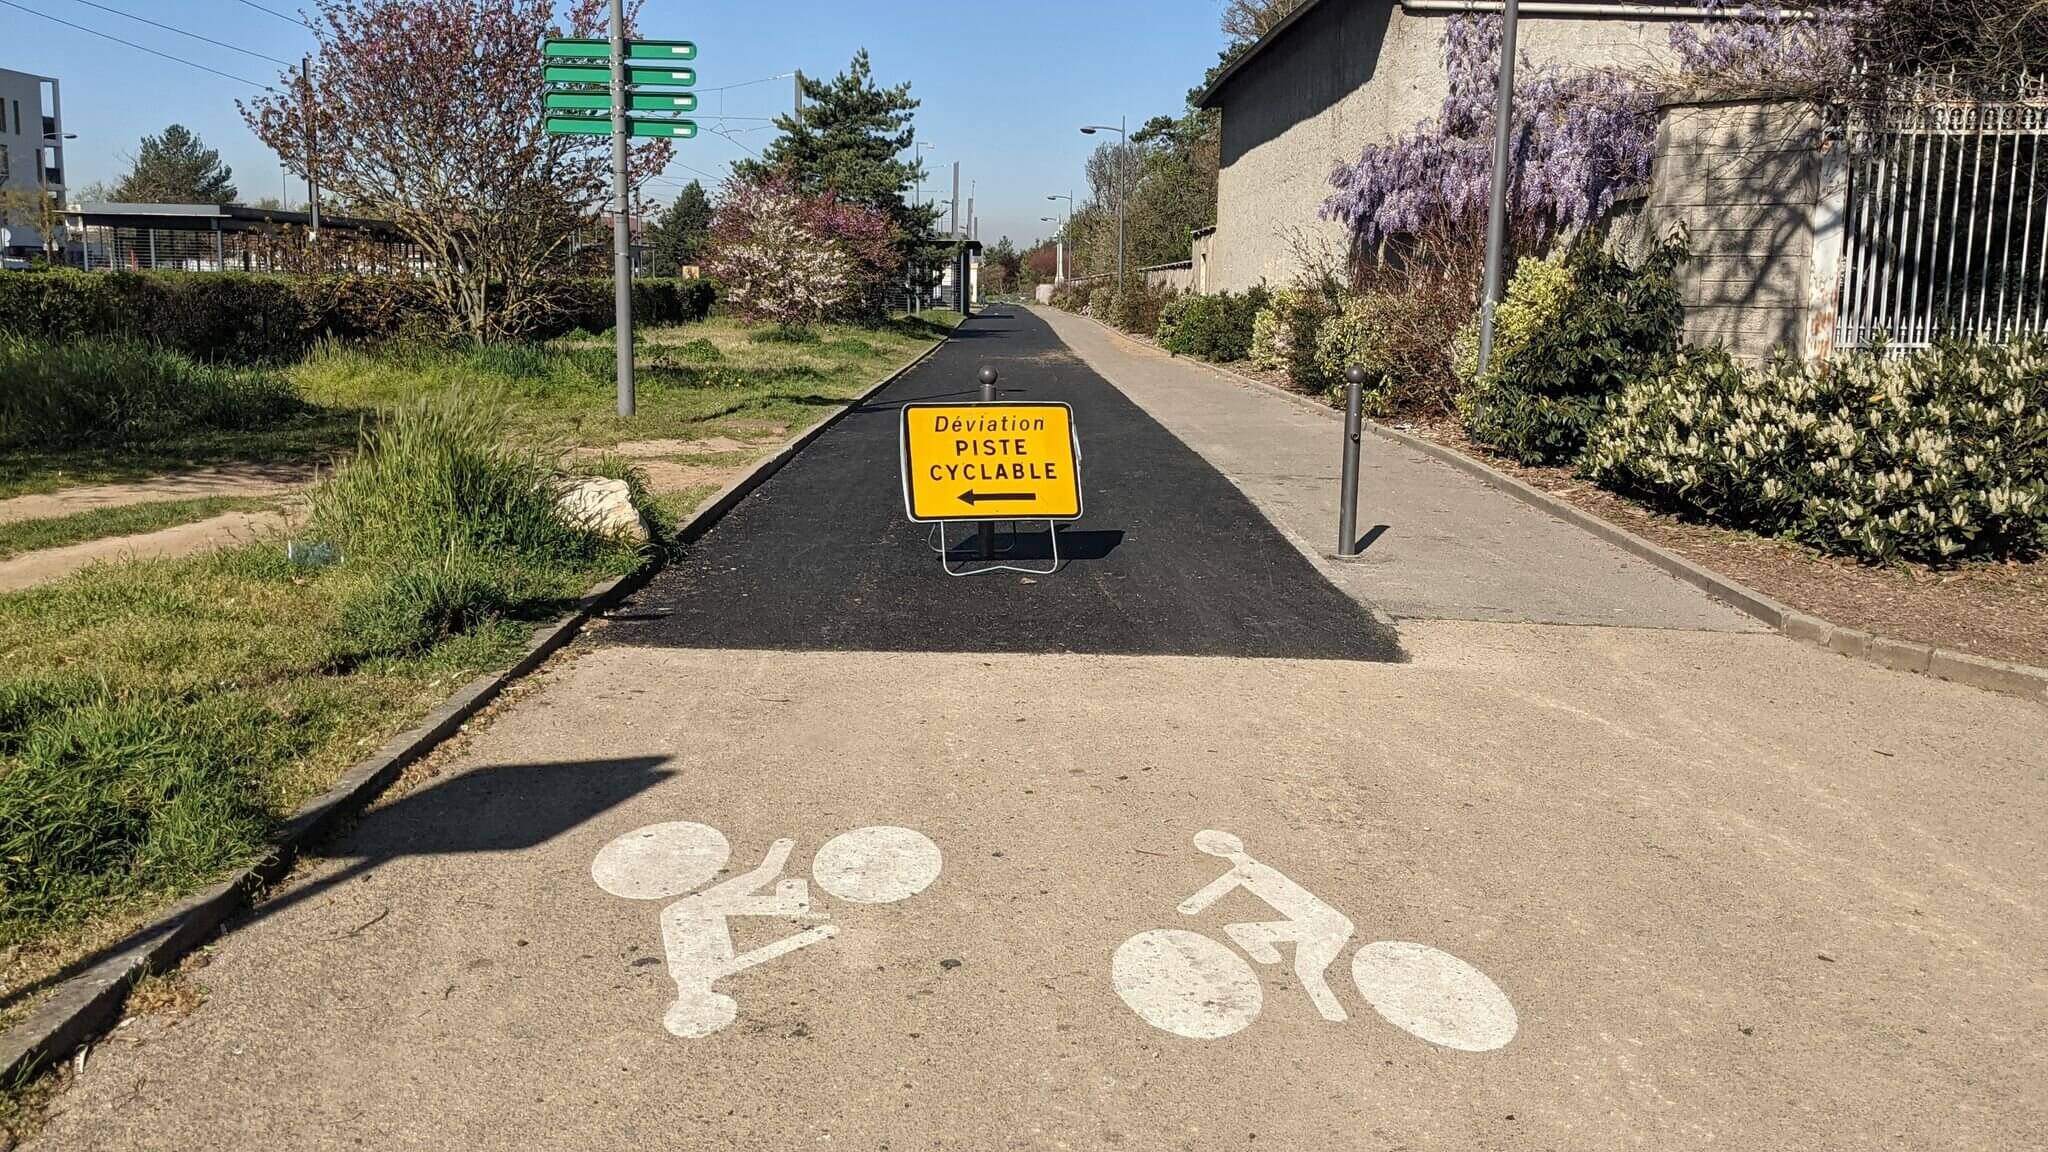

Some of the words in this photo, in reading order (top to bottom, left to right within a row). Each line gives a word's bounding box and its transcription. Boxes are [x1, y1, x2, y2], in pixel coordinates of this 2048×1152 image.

[934, 415, 1045, 433] Déviation
[956, 439, 1028, 456] PISTE
[930, 463, 1057, 481] CYCLABLE
